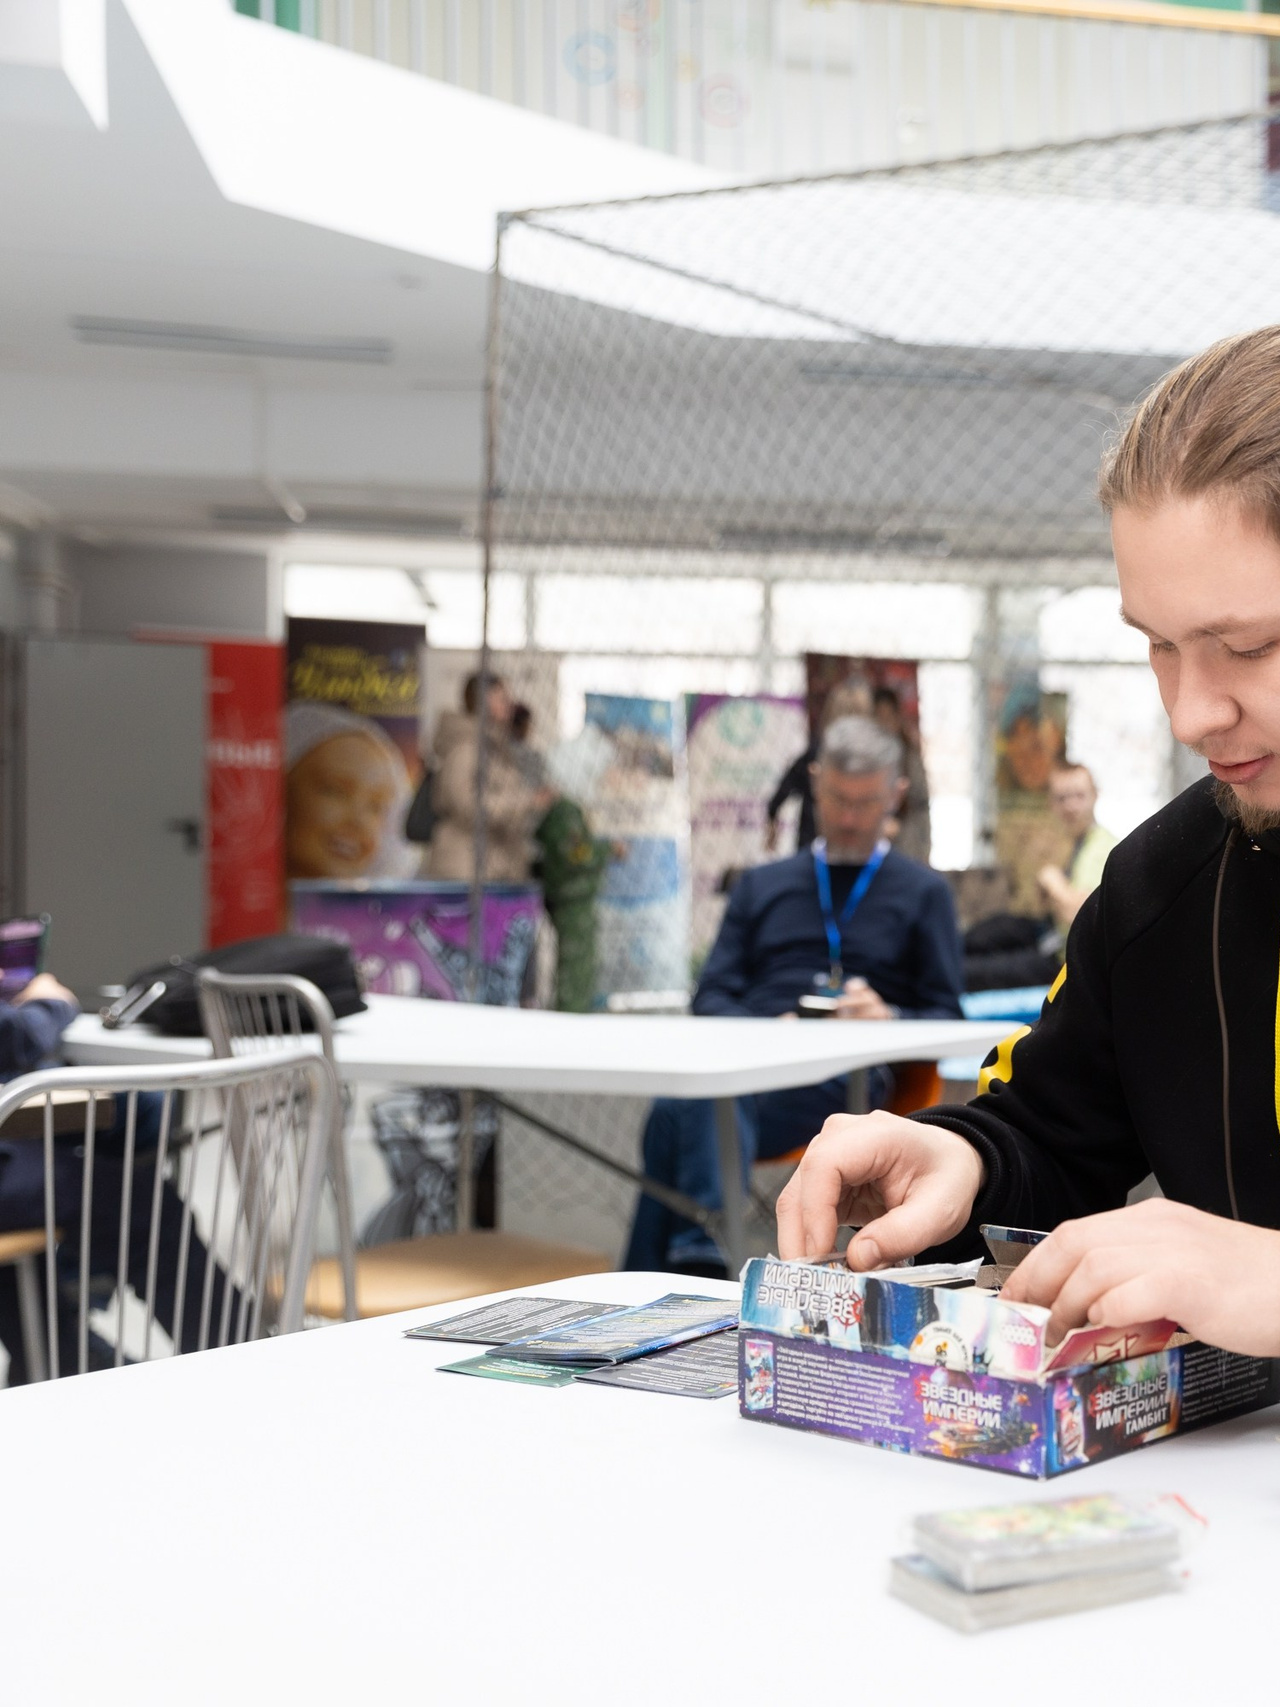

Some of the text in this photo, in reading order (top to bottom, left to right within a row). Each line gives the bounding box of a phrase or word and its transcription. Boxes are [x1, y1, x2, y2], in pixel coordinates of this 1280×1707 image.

[763, 1263, 855, 1295] ИМПЕРИИ
[922, 1399, 1001, 1429] ИМПЕРИИ
[1126, 1407, 1168, 1435] ГАМБИТ
